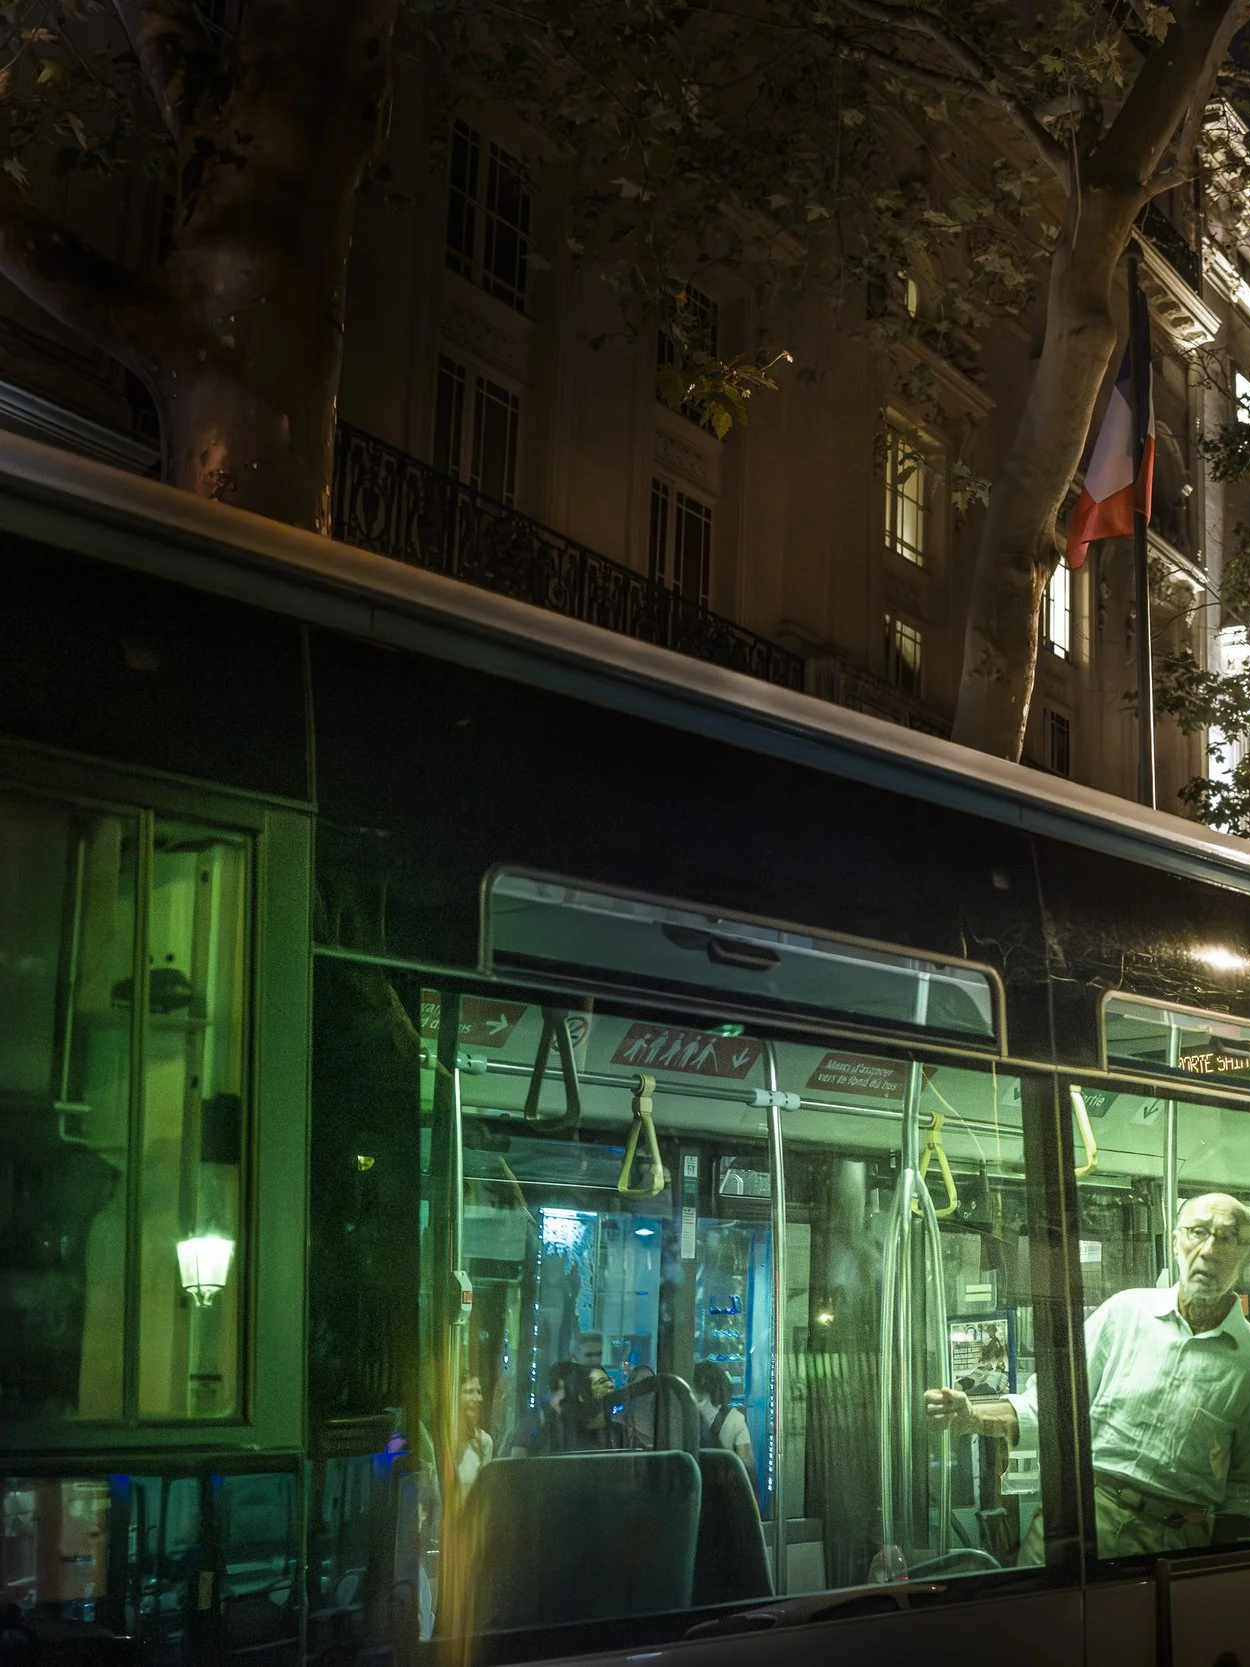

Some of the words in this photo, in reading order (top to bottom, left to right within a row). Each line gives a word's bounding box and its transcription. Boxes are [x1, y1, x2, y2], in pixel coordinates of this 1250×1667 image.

[825, 1059, 851, 1072] Merci
[817, 1073, 839, 1084] vers
[848, 1075, 870, 1087] fond
[869, 1078, 881, 1089] du
[881, 1080, 898, 1091] bus
